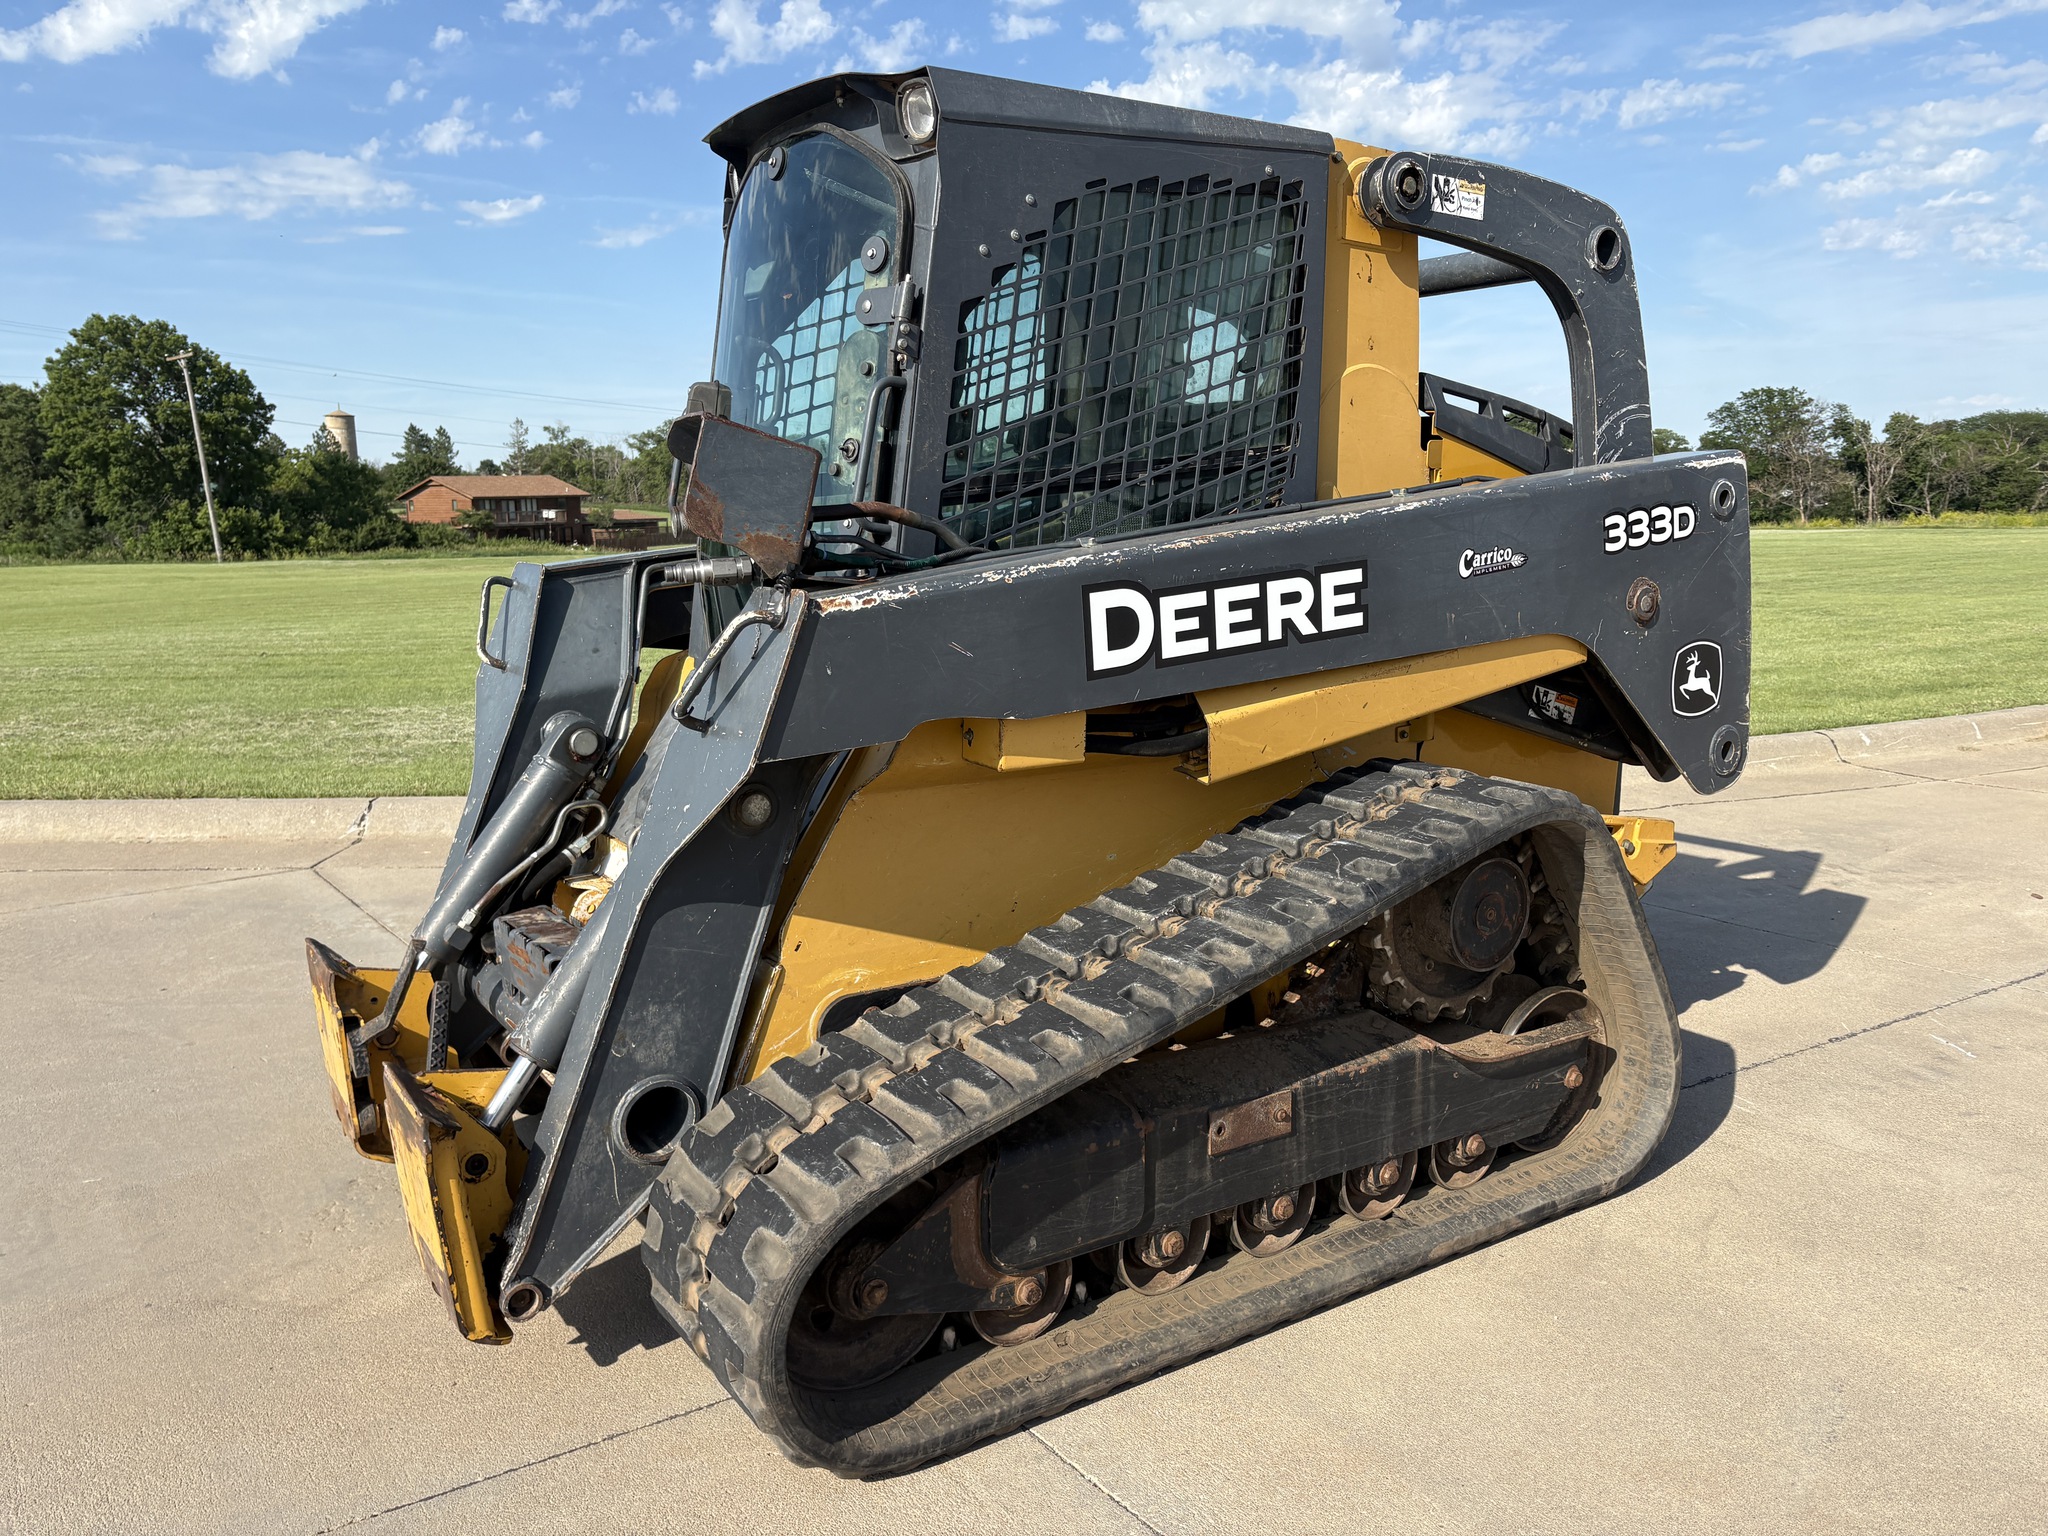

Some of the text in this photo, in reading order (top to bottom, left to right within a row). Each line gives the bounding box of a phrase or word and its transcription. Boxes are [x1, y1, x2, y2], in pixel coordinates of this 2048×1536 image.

[1604, 505, 1695, 552] 333D
[1458, 546, 1513, 578] Carrico
[1473, 563, 1510, 576] IMPLEMENT
[1089, 567, 1364, 672] DEERE
